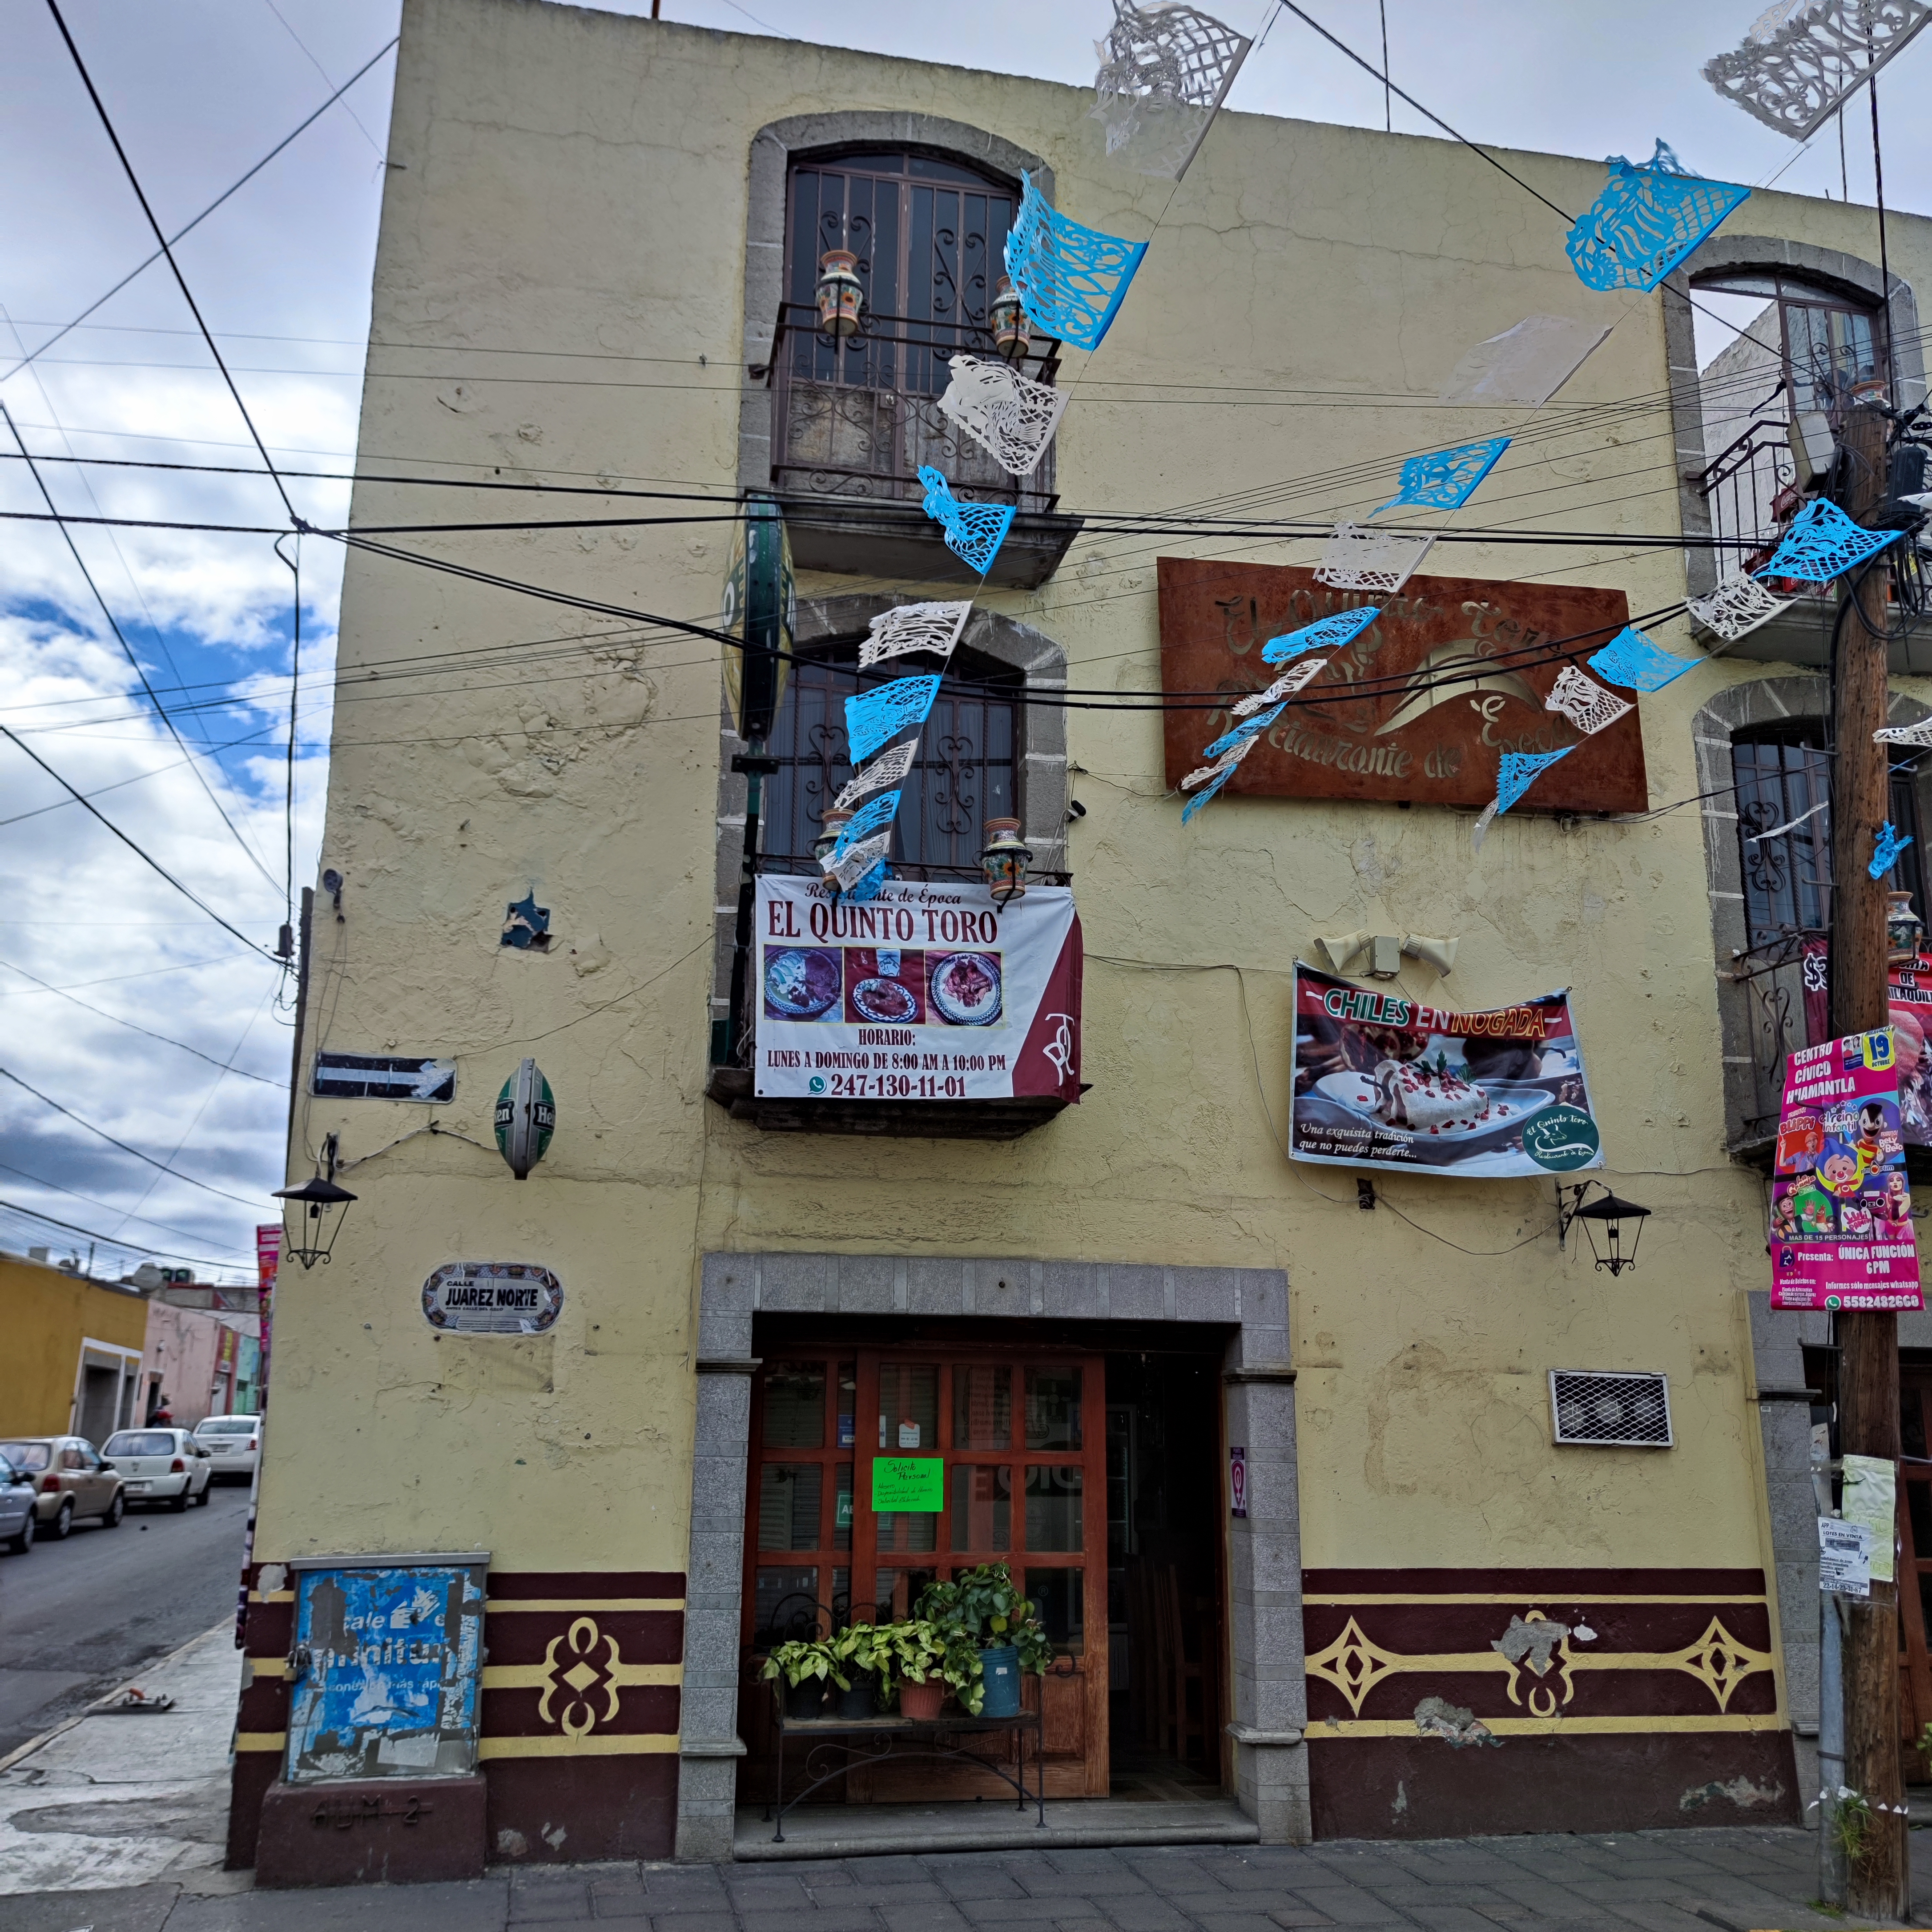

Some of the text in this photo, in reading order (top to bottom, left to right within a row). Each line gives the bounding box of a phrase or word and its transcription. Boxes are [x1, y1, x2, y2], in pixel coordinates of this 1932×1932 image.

[898, 888, 914, 903] de
[918, 883, 962, 908] Época
[767, 900, 998, 944] EL QUINTO TORO
[1900, 972, 1915, 986] DE
[1324, 988, 1546, 1038] CHILES EN NOGADA
[858, 1028, 916, 1046] HORARIO:
[1869, 1034, 1890, 1061] 19
[767, 1049, 1006, 1071] LUNES A DOMINGO DE 8:00 AM A 10:00 PM
[1794, 1041, 1833, 1067] CENTRO
[1872, 1059, 1891, 1068] OCTUBRE
[1795, 1060, 1832, 1084] CÍVICO
[830, 1073, 966, 1098] 247-130-11-01
[1786, 1076, 1856, 1105] HUAMANTLA
[1787, 1107, 1807, 1119] TRIBUTO!
[1300, 1123, 1414, 1144] Una exquisita tradición
[1526, 1126, 1537, 1135] El
[1537, 1114, 1569, 1129] Quinto
[1299, 1140, 1417, 1158] que no puedes perderte...
[1798, 1252, 1834, 1262] Presenta:
[1838, 1241, 1916, 1260] ÚNICA FUNCIÓN
[1825, 1280, 1919, 1290] Informes sólo mensajes whatsapp
[445, 1288, 539, 1307] JUAREZ NORTE
[1843, 1295, 1920, 1308] 5582482660
